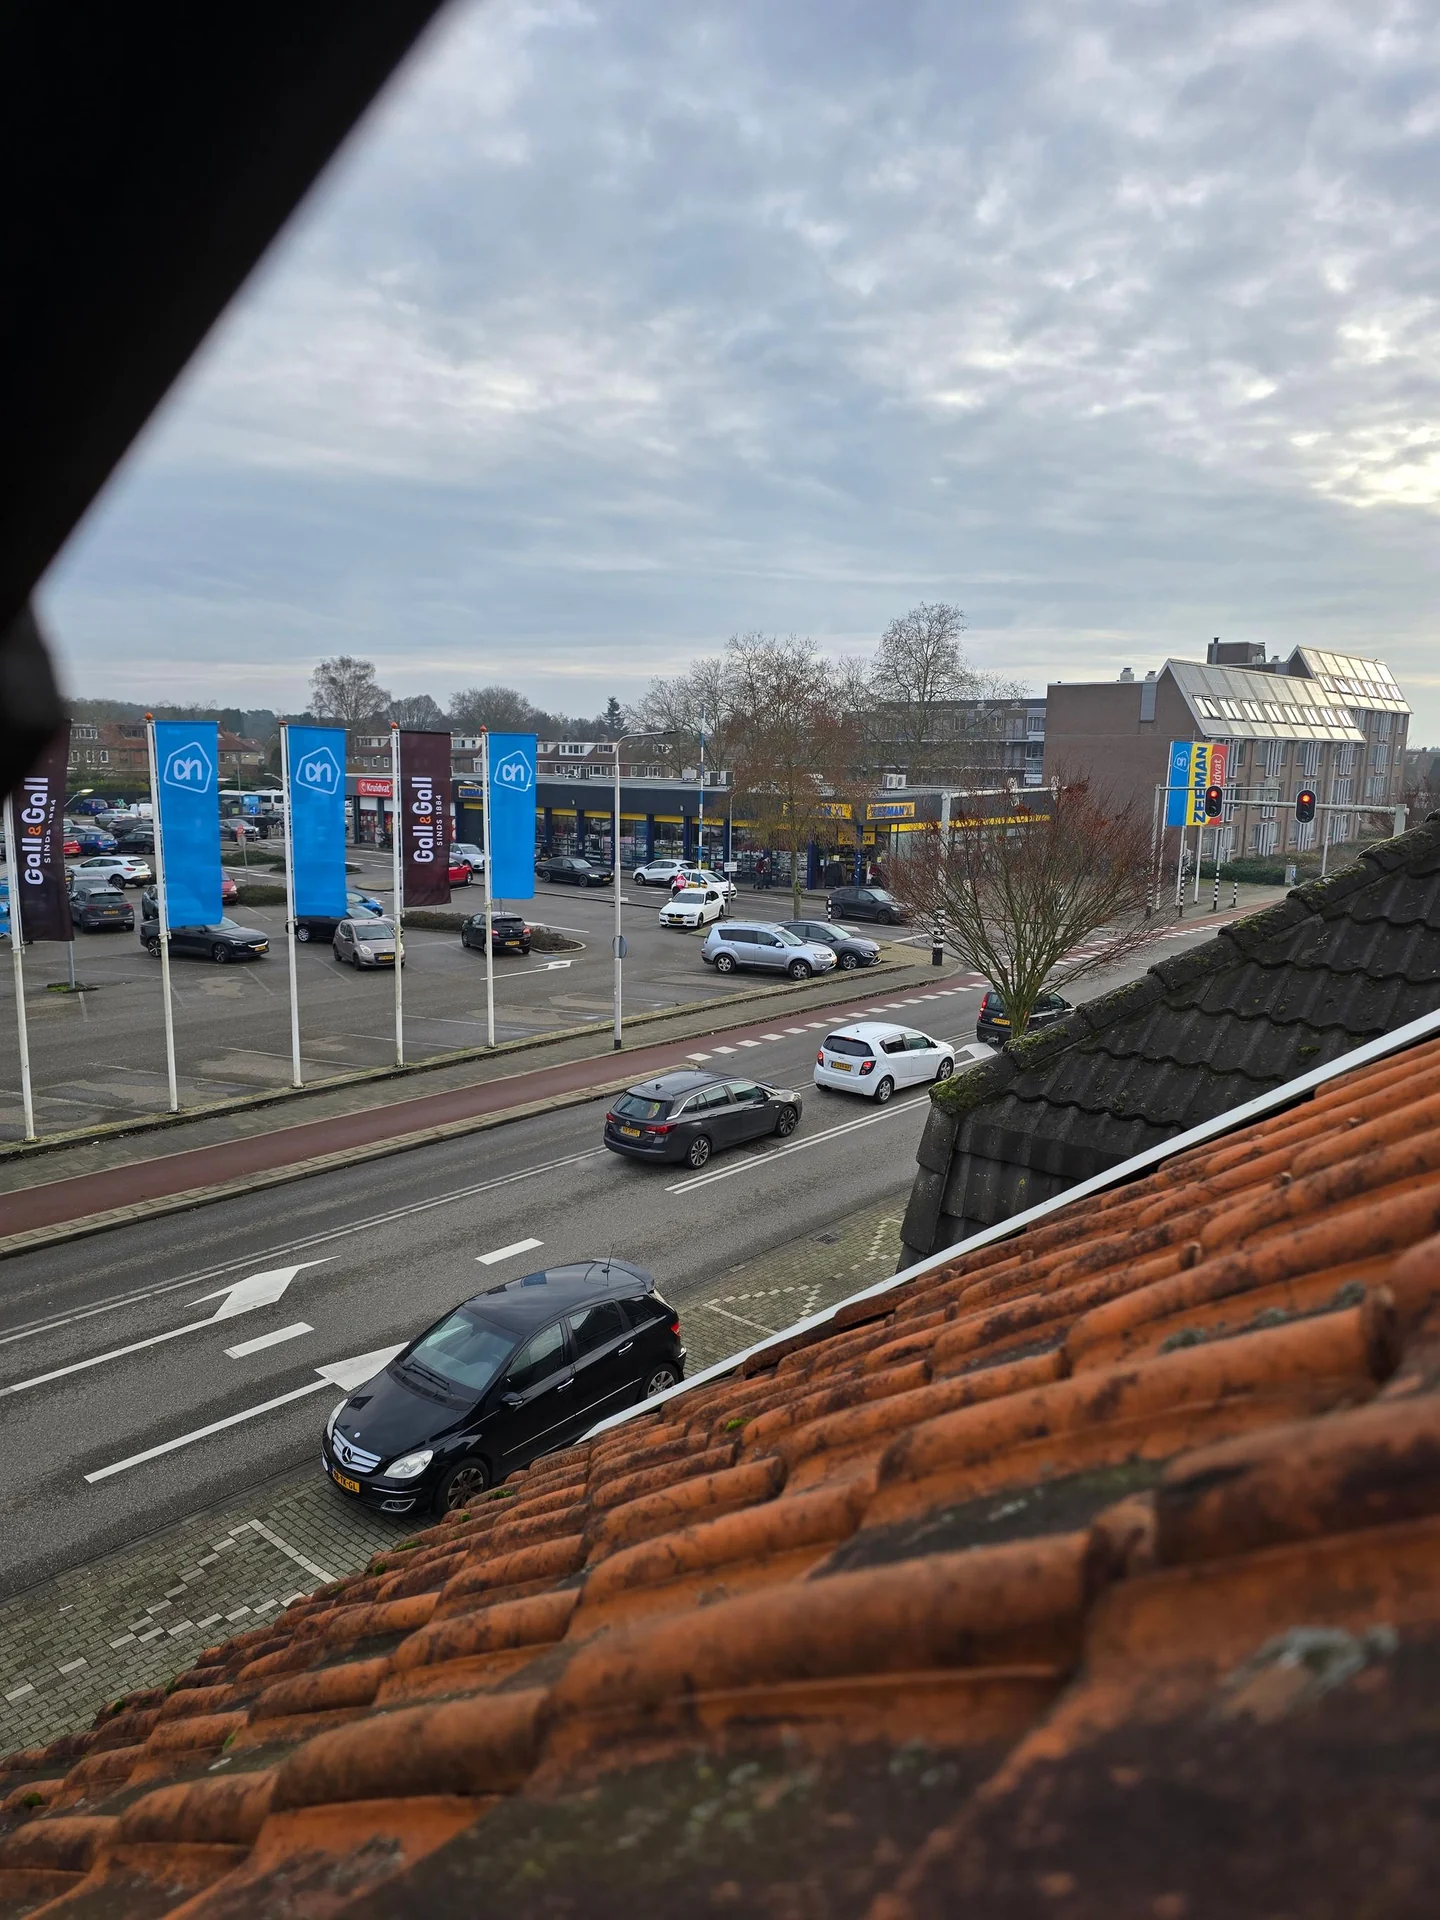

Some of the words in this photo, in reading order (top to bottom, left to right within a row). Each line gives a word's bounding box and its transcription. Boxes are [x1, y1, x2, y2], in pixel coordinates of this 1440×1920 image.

[21, 777, 49, 824] Gall
[411, 776, 433, 815] Gall
[1193, 747, 1208, 823] ZEEMAN
[419, 815, 432, 824] &
[435, 794, 443, 815] 1884
[28, 825, 42, 836] &
[412, 825, 434, 863] Gall
[22, 837, 44, 885] Gall
